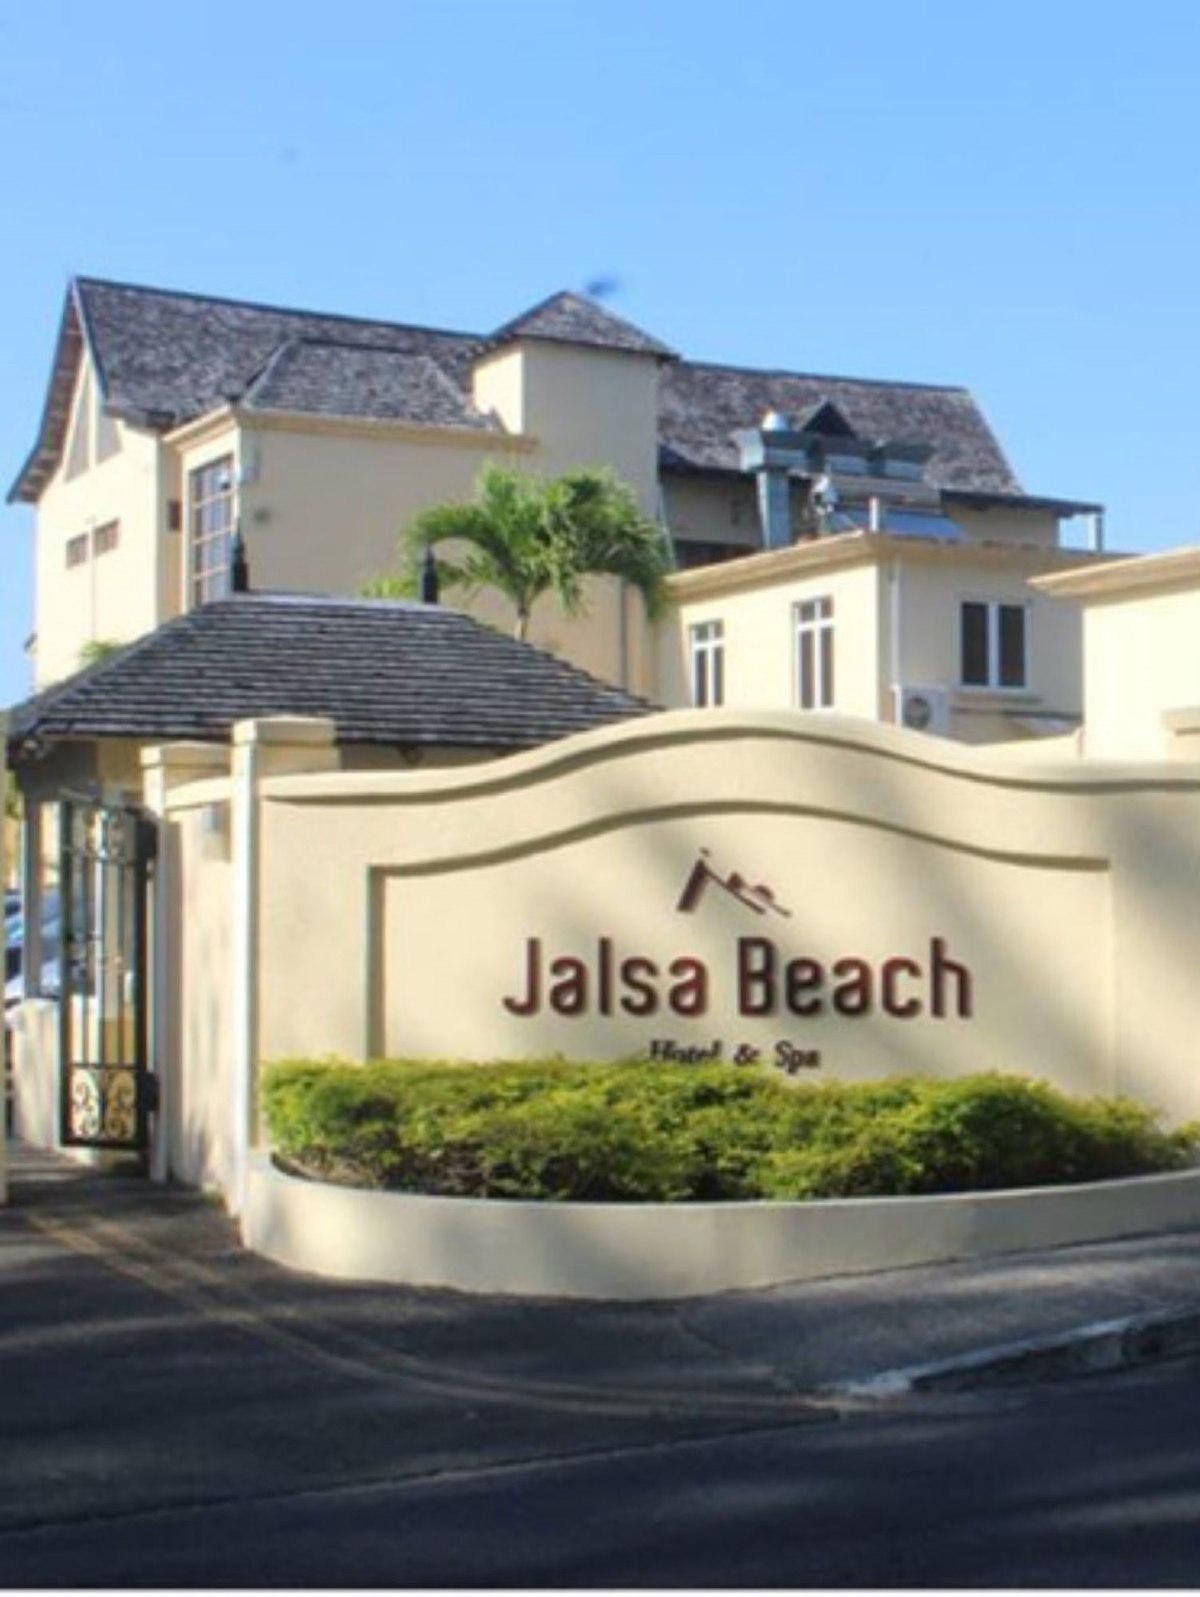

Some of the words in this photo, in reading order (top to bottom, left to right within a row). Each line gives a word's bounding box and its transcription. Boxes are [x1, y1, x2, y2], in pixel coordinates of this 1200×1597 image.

[502, 936, 708, 1018] Jalsa
[737, 936, 973, 1019] Beach
[650, 1039, 723, 1064] Hotel
[734, 1043, 760, 1066] &
[774, 1039, 821, 1075] Spa
